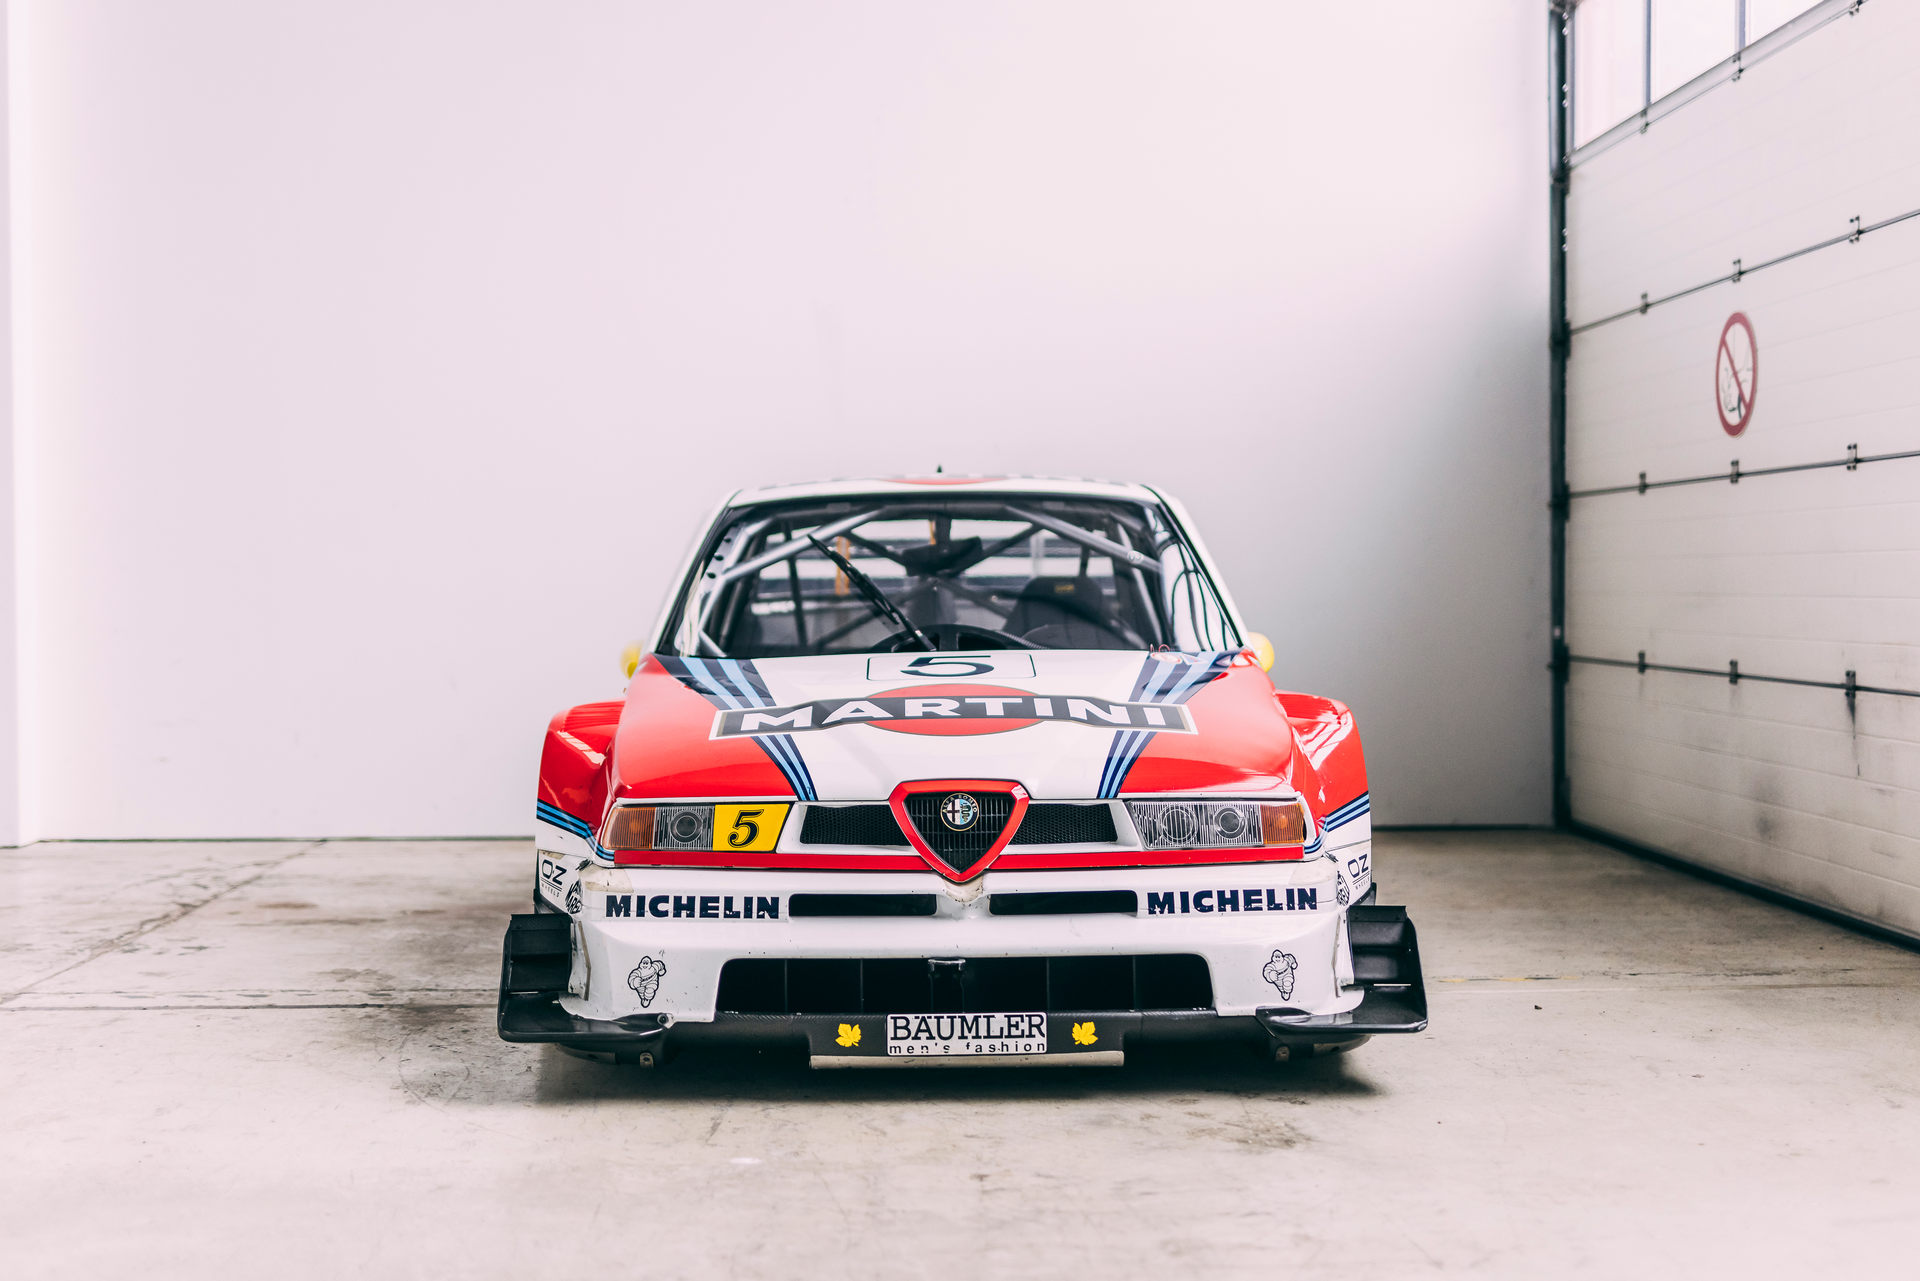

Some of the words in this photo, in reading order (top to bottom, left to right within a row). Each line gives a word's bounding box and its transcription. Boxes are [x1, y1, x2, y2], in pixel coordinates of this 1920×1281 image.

[900, 655, 995, 677] 5
[740, 697, 1168, 731] MARTINI
[728, 809, 764, 848] 5
[1347, 853, 1369, 878] OZ
[605, 895, 780, 919] MICHELIN
[1147, 888, 1317, 915] MICHELIN
[890, 1014, 1046, 1041] BÄUMLER
[889, 1042, 950, 1054] men's
[966, 1041, 1045, 1053] fashion
